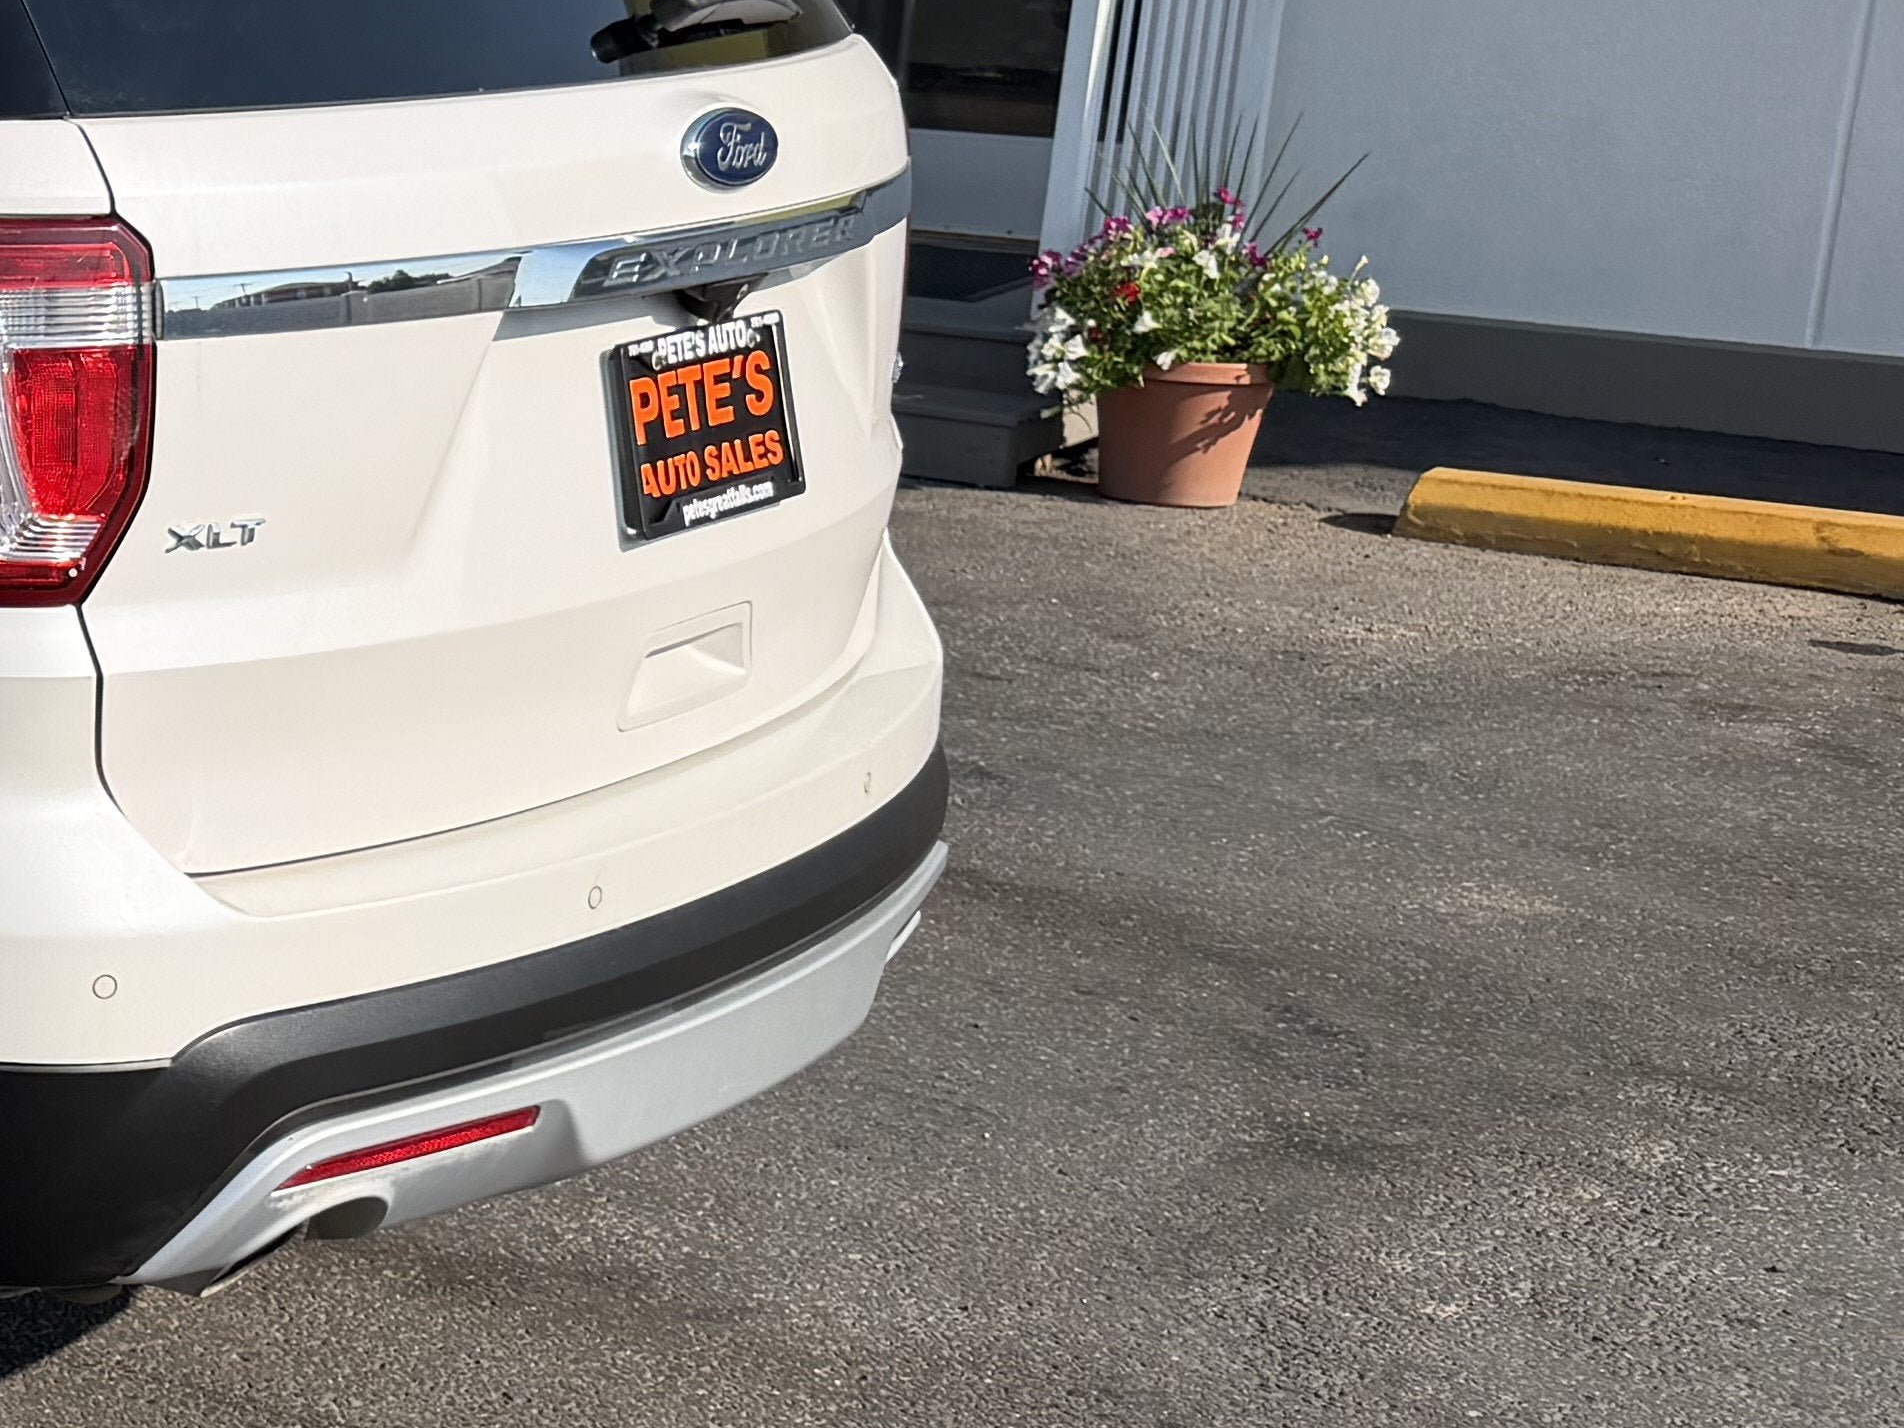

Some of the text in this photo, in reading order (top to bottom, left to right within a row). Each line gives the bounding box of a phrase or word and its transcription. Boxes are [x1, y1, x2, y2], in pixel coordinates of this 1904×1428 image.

[716, 120, 768, 171] Ford
[603, 215, 855, 288] EXPLORER
[708, 318, 748, 355] AUTO
[629, 349, 774, 446] PETE'S
[640, 429, 784, 498] AUTO SALES
[164, 517, 267, 554] XLT
